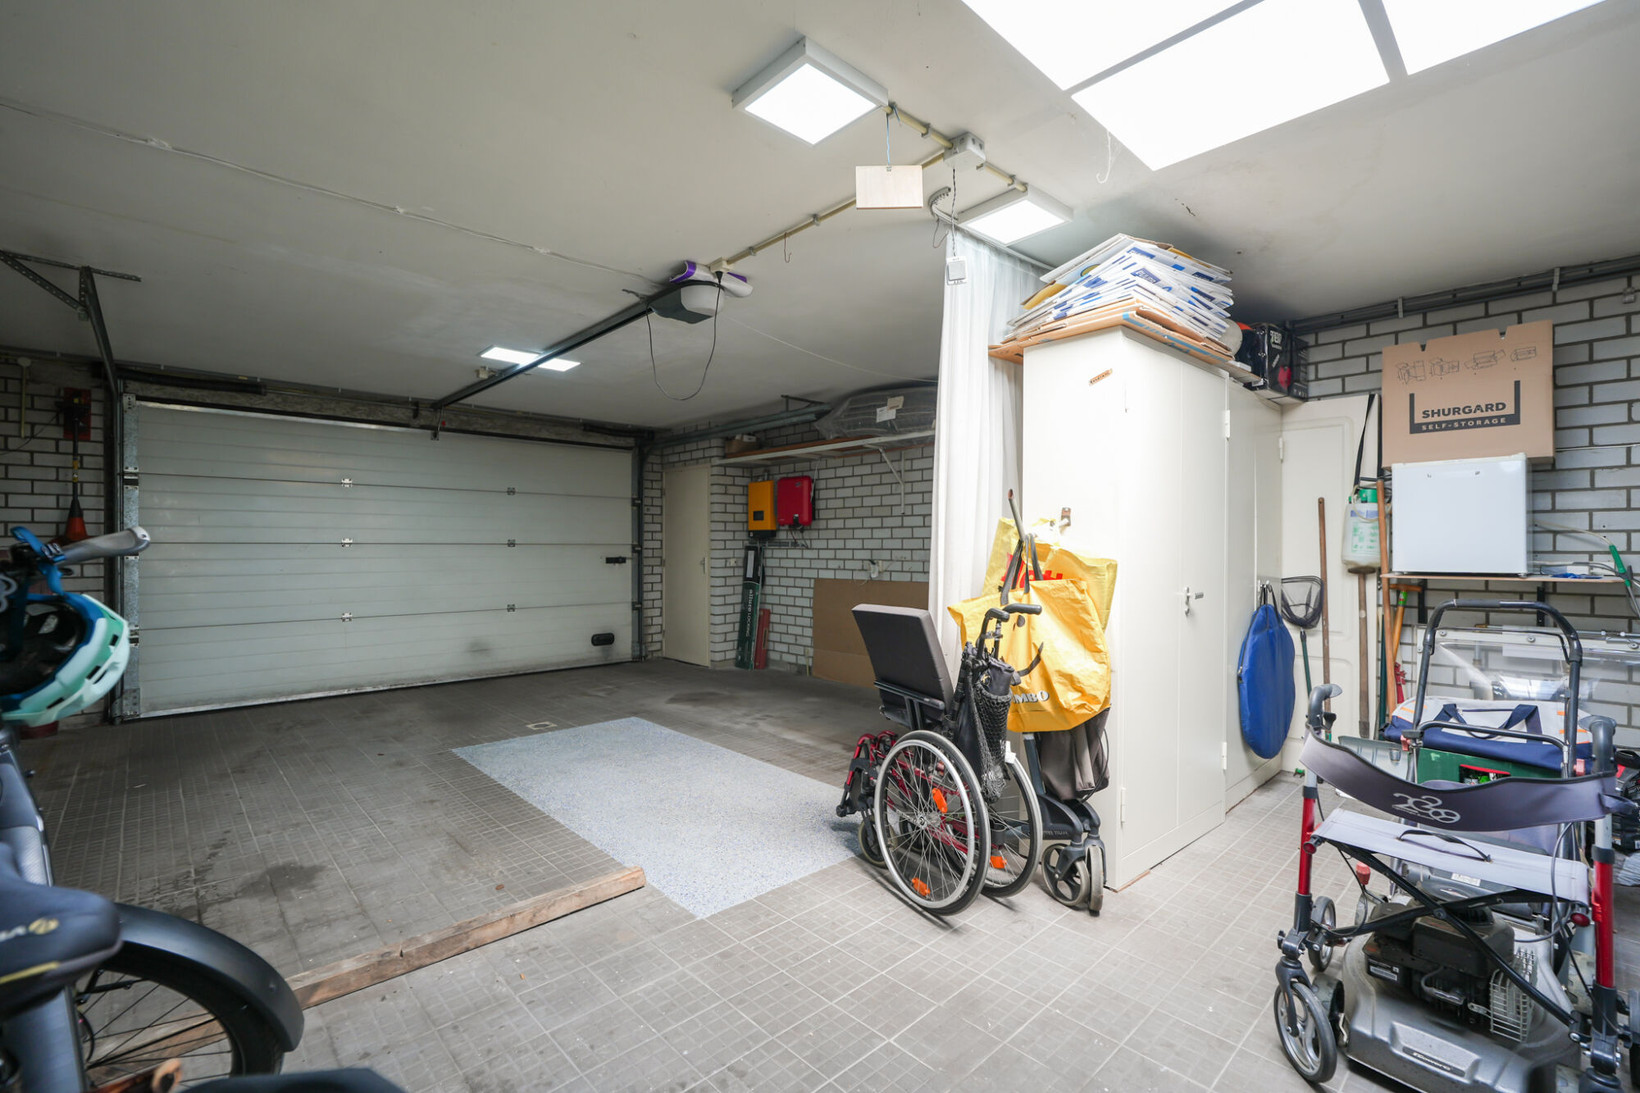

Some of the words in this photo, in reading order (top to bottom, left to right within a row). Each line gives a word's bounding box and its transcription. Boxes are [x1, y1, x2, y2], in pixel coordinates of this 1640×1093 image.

[1422, 402, 1506, 419] SHURGARD
[1421, 417, 1506, 431] SELF-STORAGE
[1012, 690, 1049, 704] MBO
